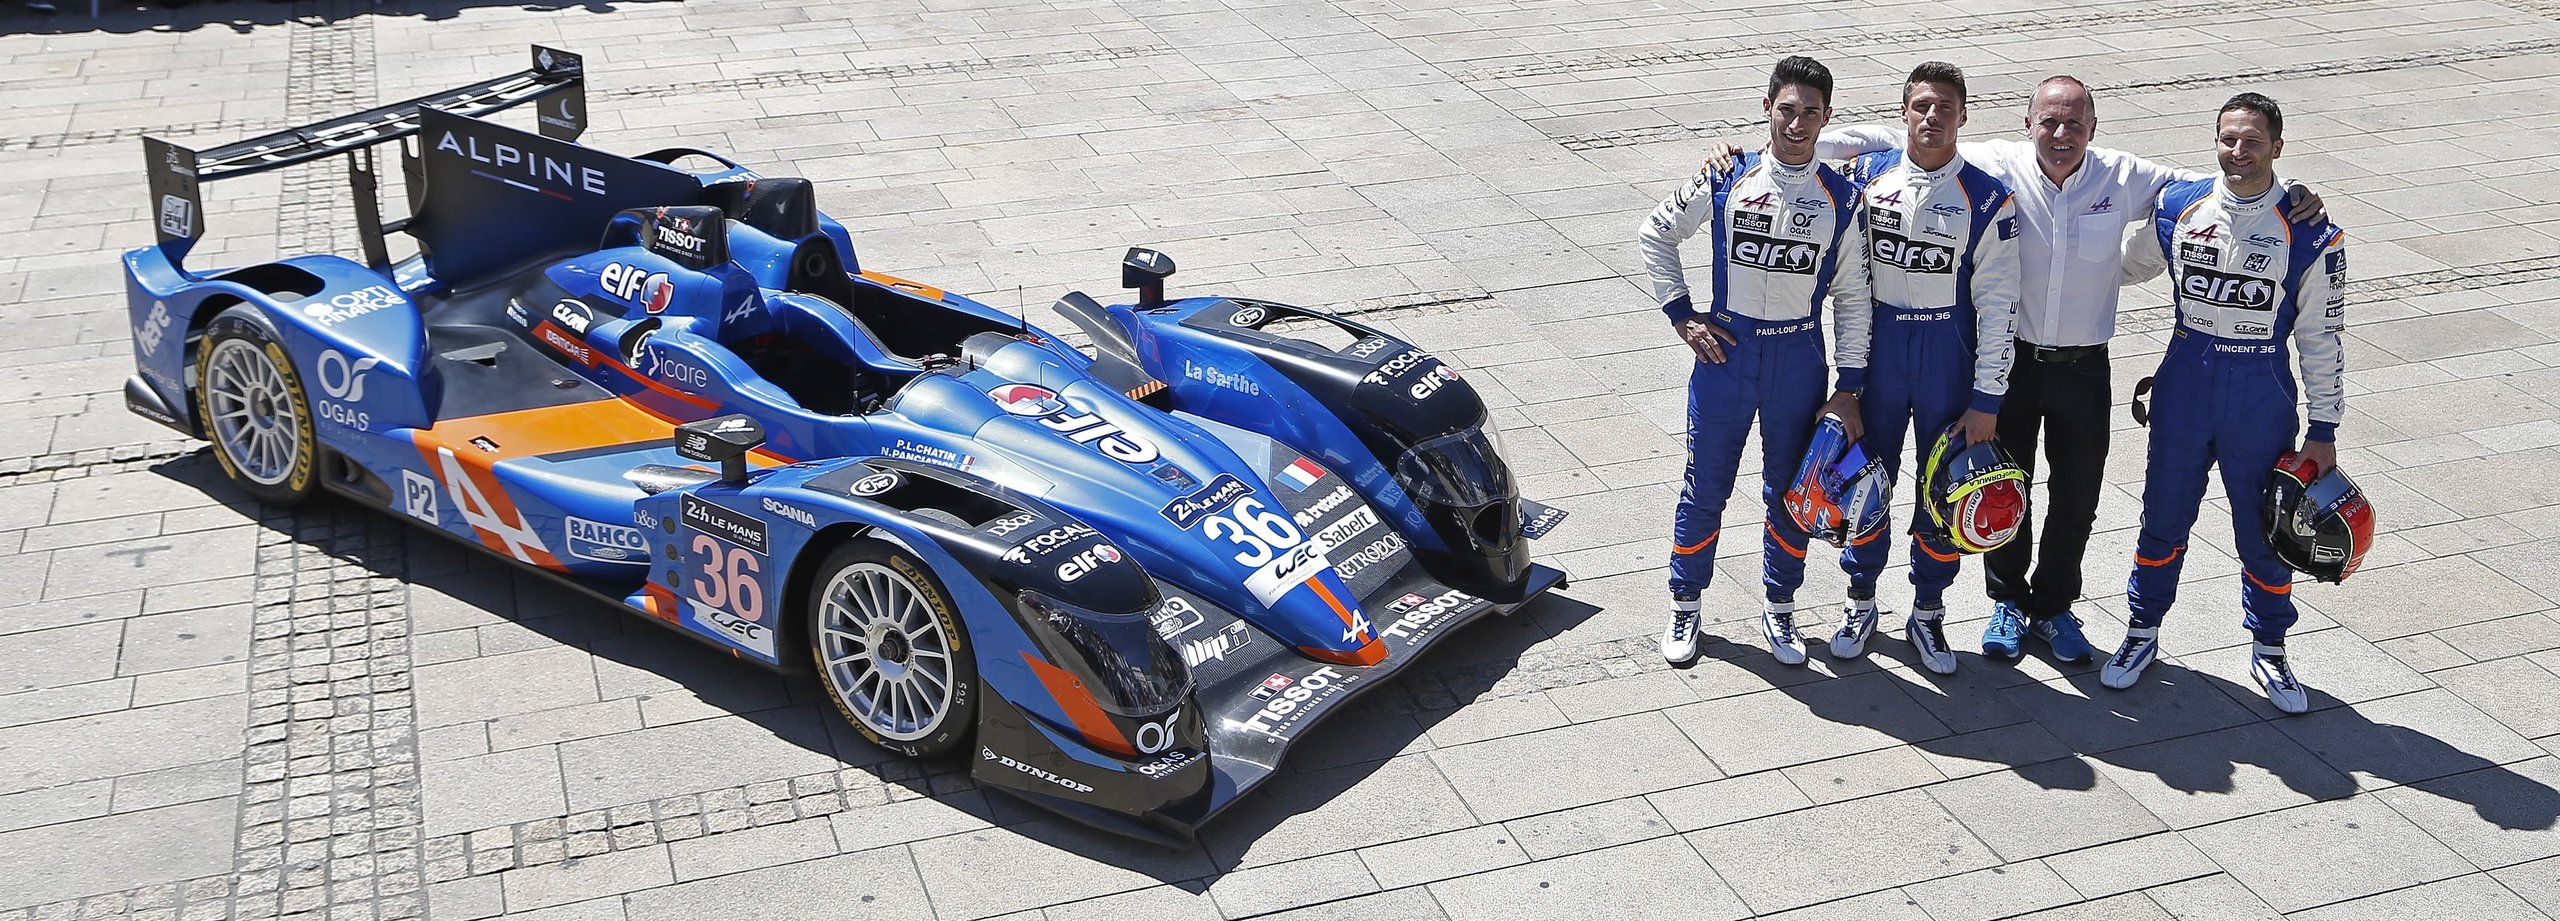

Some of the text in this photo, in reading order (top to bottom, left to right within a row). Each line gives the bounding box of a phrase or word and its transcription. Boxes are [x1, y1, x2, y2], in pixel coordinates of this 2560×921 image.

[437, 130, 606, 195] ALPINE
[1795, 197, 1829, 209] WEC
[1932, 203, 1966, 215] WEC
[1980, 190, 1999, 213] Sabelt
[1735, 217, 1769, 229] TISSOT
[1789, 226, 1812, 236] OGAS
[1871, 213, 1900, 226] TISSOT
[658, 226, 706, 252] TISSOT
[1874, 239, 1921, 267] elf
[2250, 233, 2284, 247] WEC
[1735, 241, 1787, 266] elf
[2183, 250, 2216, 262] TISSOT
[600, 262, 647, 300] elf
[2184, 274, 2240, 302] elf
[319, 295, 407, 326] FINANCE
[331, 286, 389, 308] OPTI
[134, 300, 171, 357] here
[1756, 321, 1815, 336] PAUL-LOUP 36
[1935, 312, 1951, 321] 36
[2189, 313, 2214, 328] icare
[2215, 344, 2276, 354] VINCENT 36
[660, 350, 707, 388] icare
[1185, 359, 1260, 397] La Sarthe
[1410, 370, 1443, 400] elf
[319, 400, 370, 432] OGAS
[896, 439, 957, 462] P.L.CHATIN
[1038, 412, 1160, 464] elf
[407, 477, 434, 518] P2
[1199, 496, 1215, 509] LE
[686, 501, 761, 542] 24h LE MANS
[762, 497, 817, 528] SCANIA
[1523, 508, 1559, 533] OGAS
[571, 519, 643, 548] BAHCO
[1024, 523, 1093, 553] FOCAL
[1203, 496, 1302, 568] 36
[1319, 510, 1372, 548] Sabelt
[1058, 550, 1099, 582] elf
[1275, 544, 1318, 580] WEC
[692, 534, 763, 623] 36
[711, 612, 762, 639] WEC
[1379, 589, 1472, 638] TISSOT
[1406, 629, 1429, 646] SWISS
[1427, 611, 1456, 630] WATCHES
[1240, 665, 1343, 733] TISSOT
[1290, 695, 1323, 722] WATCHES
[999, 755, 1095, 794] DUNLOP
[1138, 751, 1186, 776] OGAS
